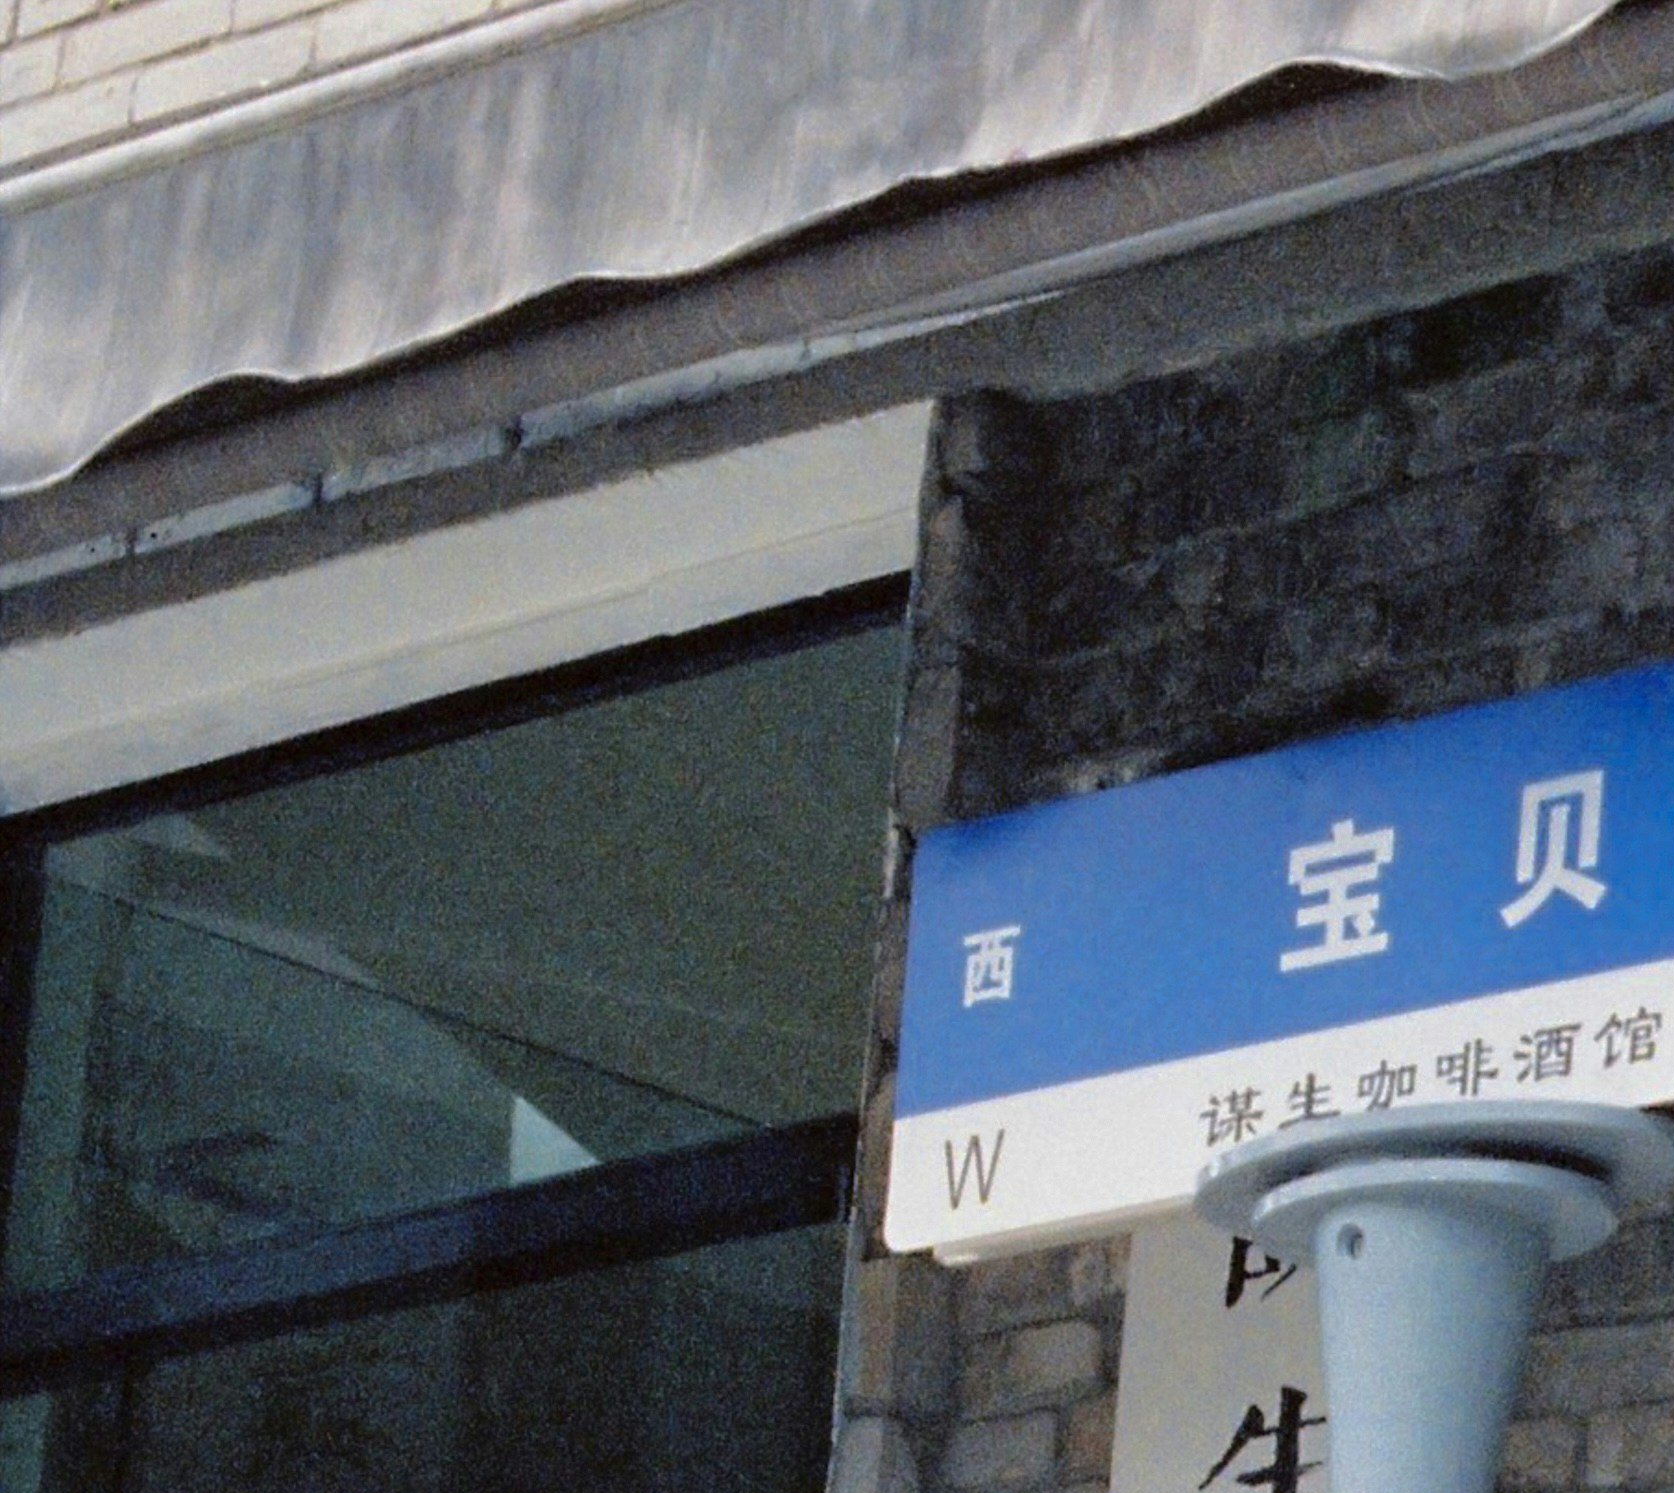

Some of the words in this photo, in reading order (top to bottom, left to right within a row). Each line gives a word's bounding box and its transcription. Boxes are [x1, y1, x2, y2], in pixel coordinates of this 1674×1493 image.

[1278, 768, 1608, 974] 宝贝
[961, 923, 1021, 1008] 西
[1199, 1006, 1664, 1147] 谋生咖啡酒馆
[943, 1127, 1006, 1211] W
